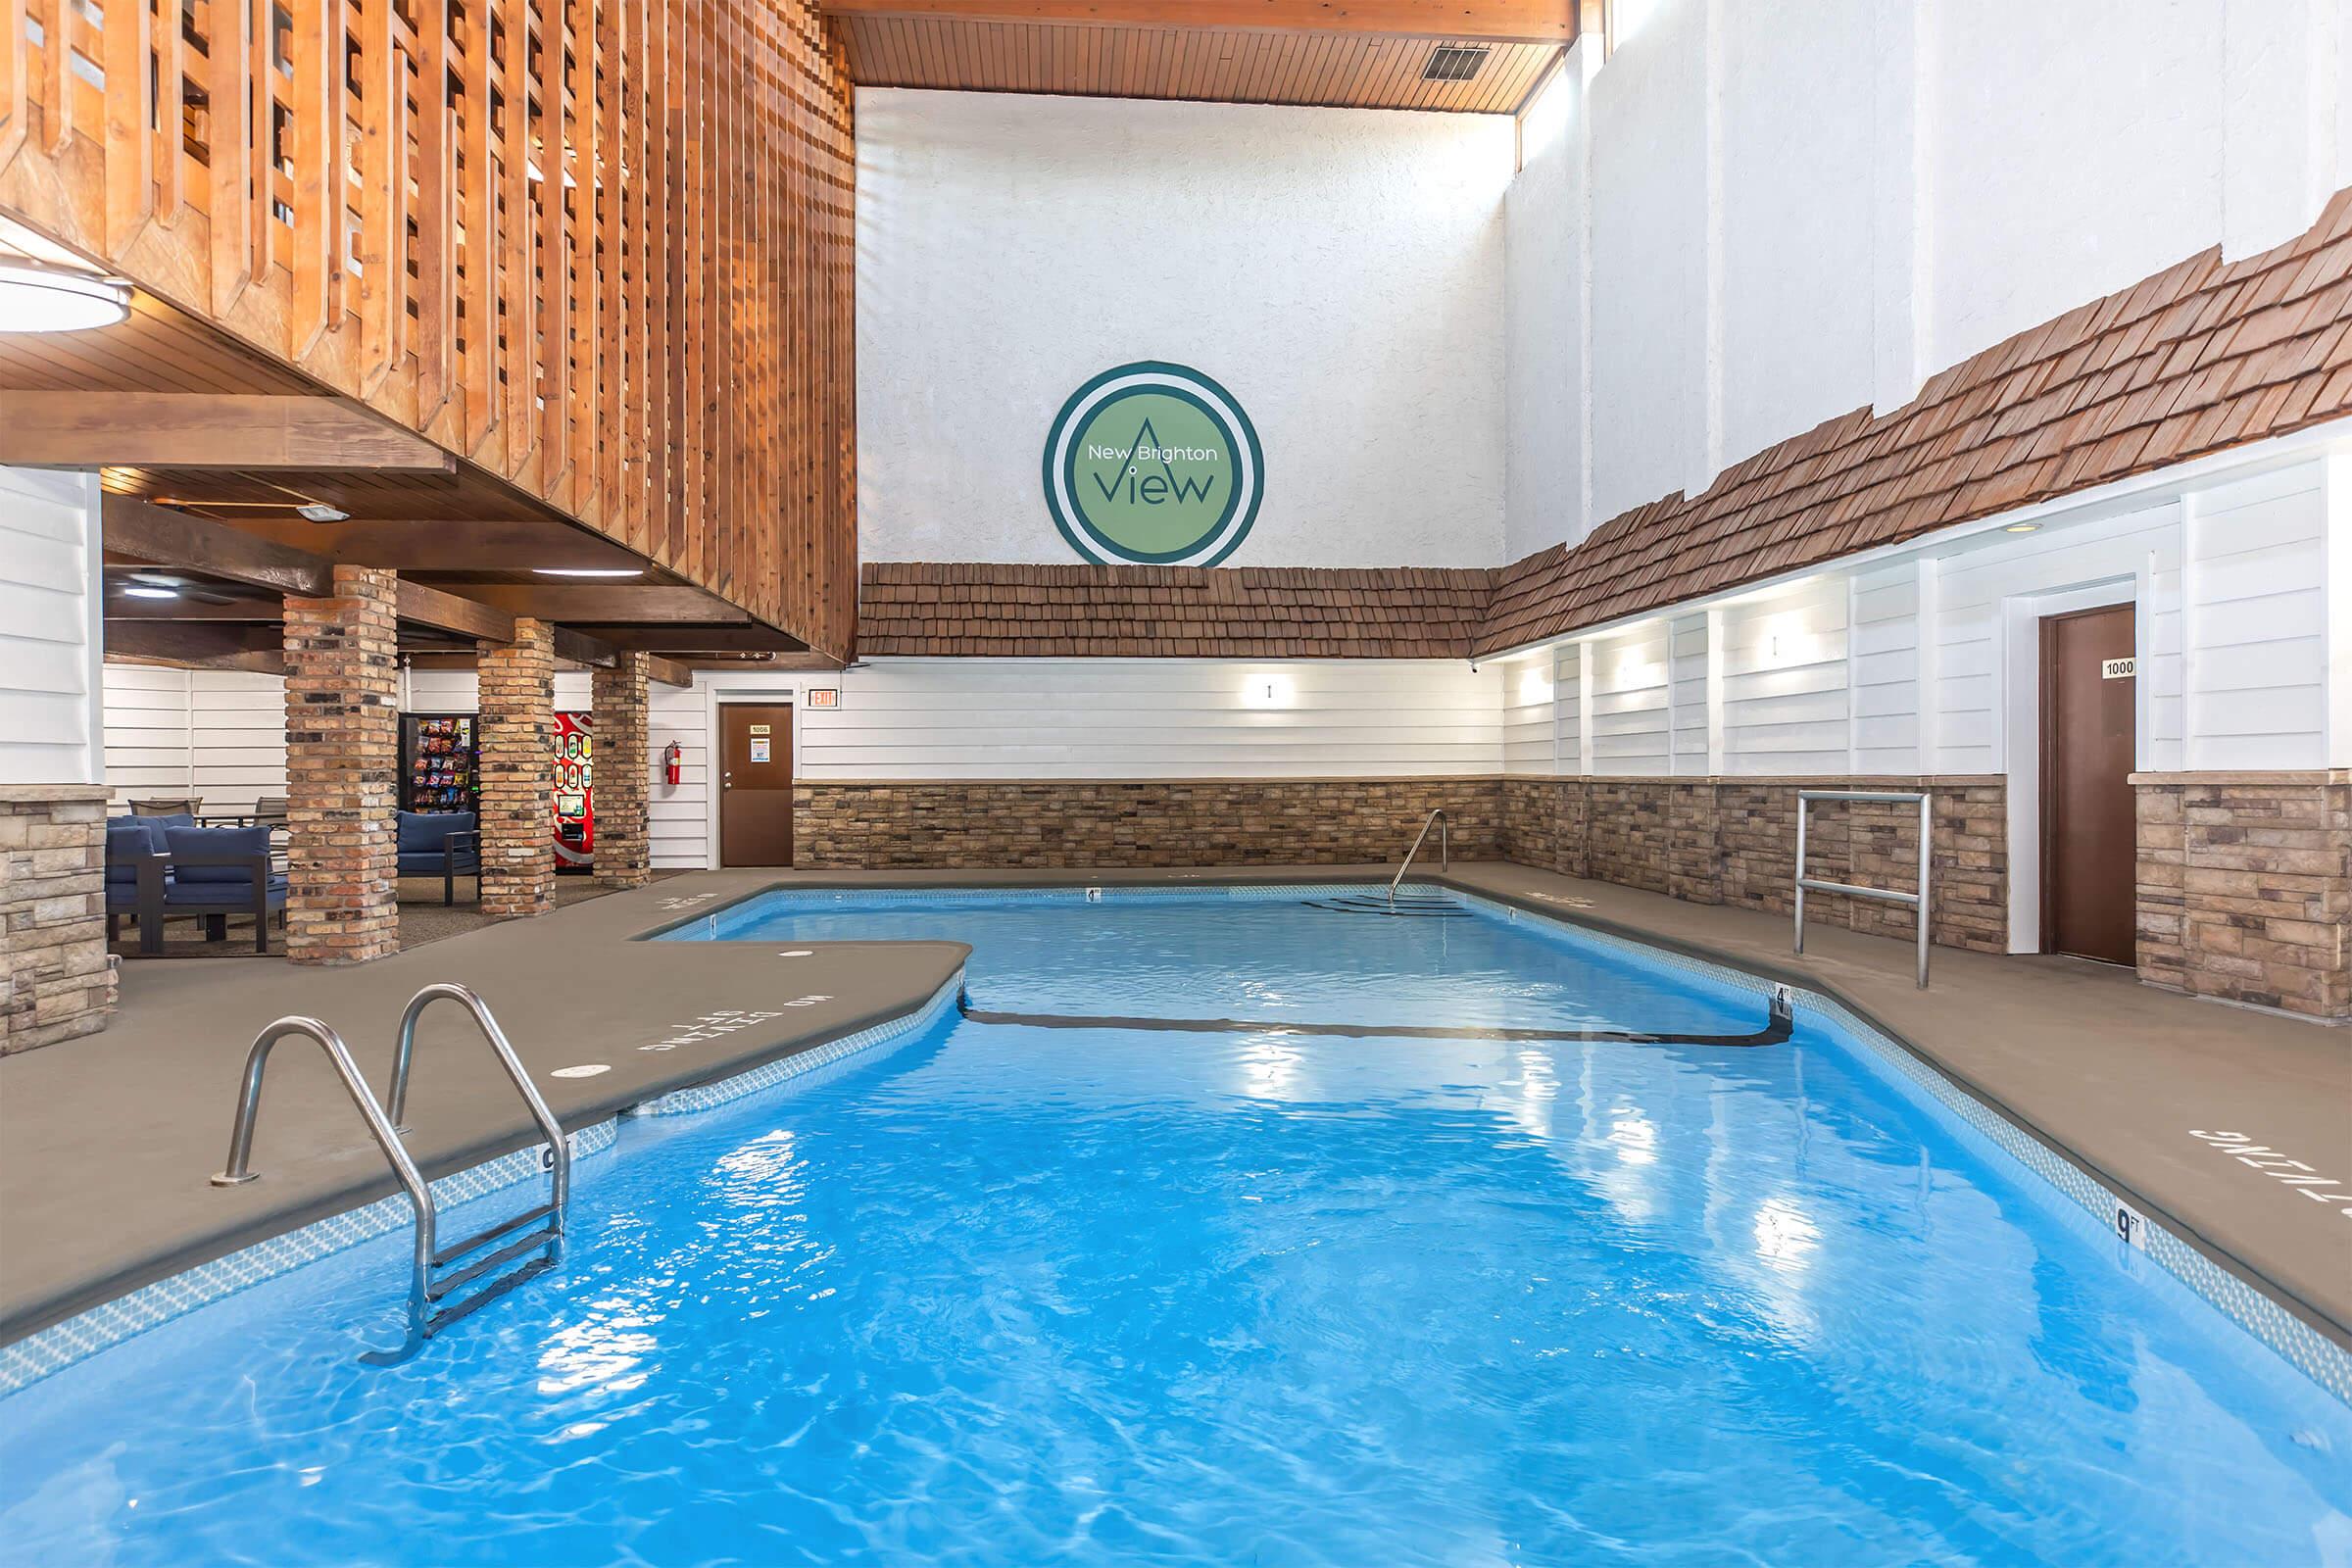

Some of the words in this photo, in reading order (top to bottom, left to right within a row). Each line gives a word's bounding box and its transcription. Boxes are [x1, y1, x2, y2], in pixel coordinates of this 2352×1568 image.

[1089, 444, 1133, 460] New
[1138, 445, 1218, 465] Brighton
[2107, 662, 2133, 674] 1000
[814, 691, 833, 706] EXIT
[1777, 988, 1785, 1001] 4
[637, 1010, 784, 1051] DIVING
[2187, 1130, 2352, 1216] IVING
